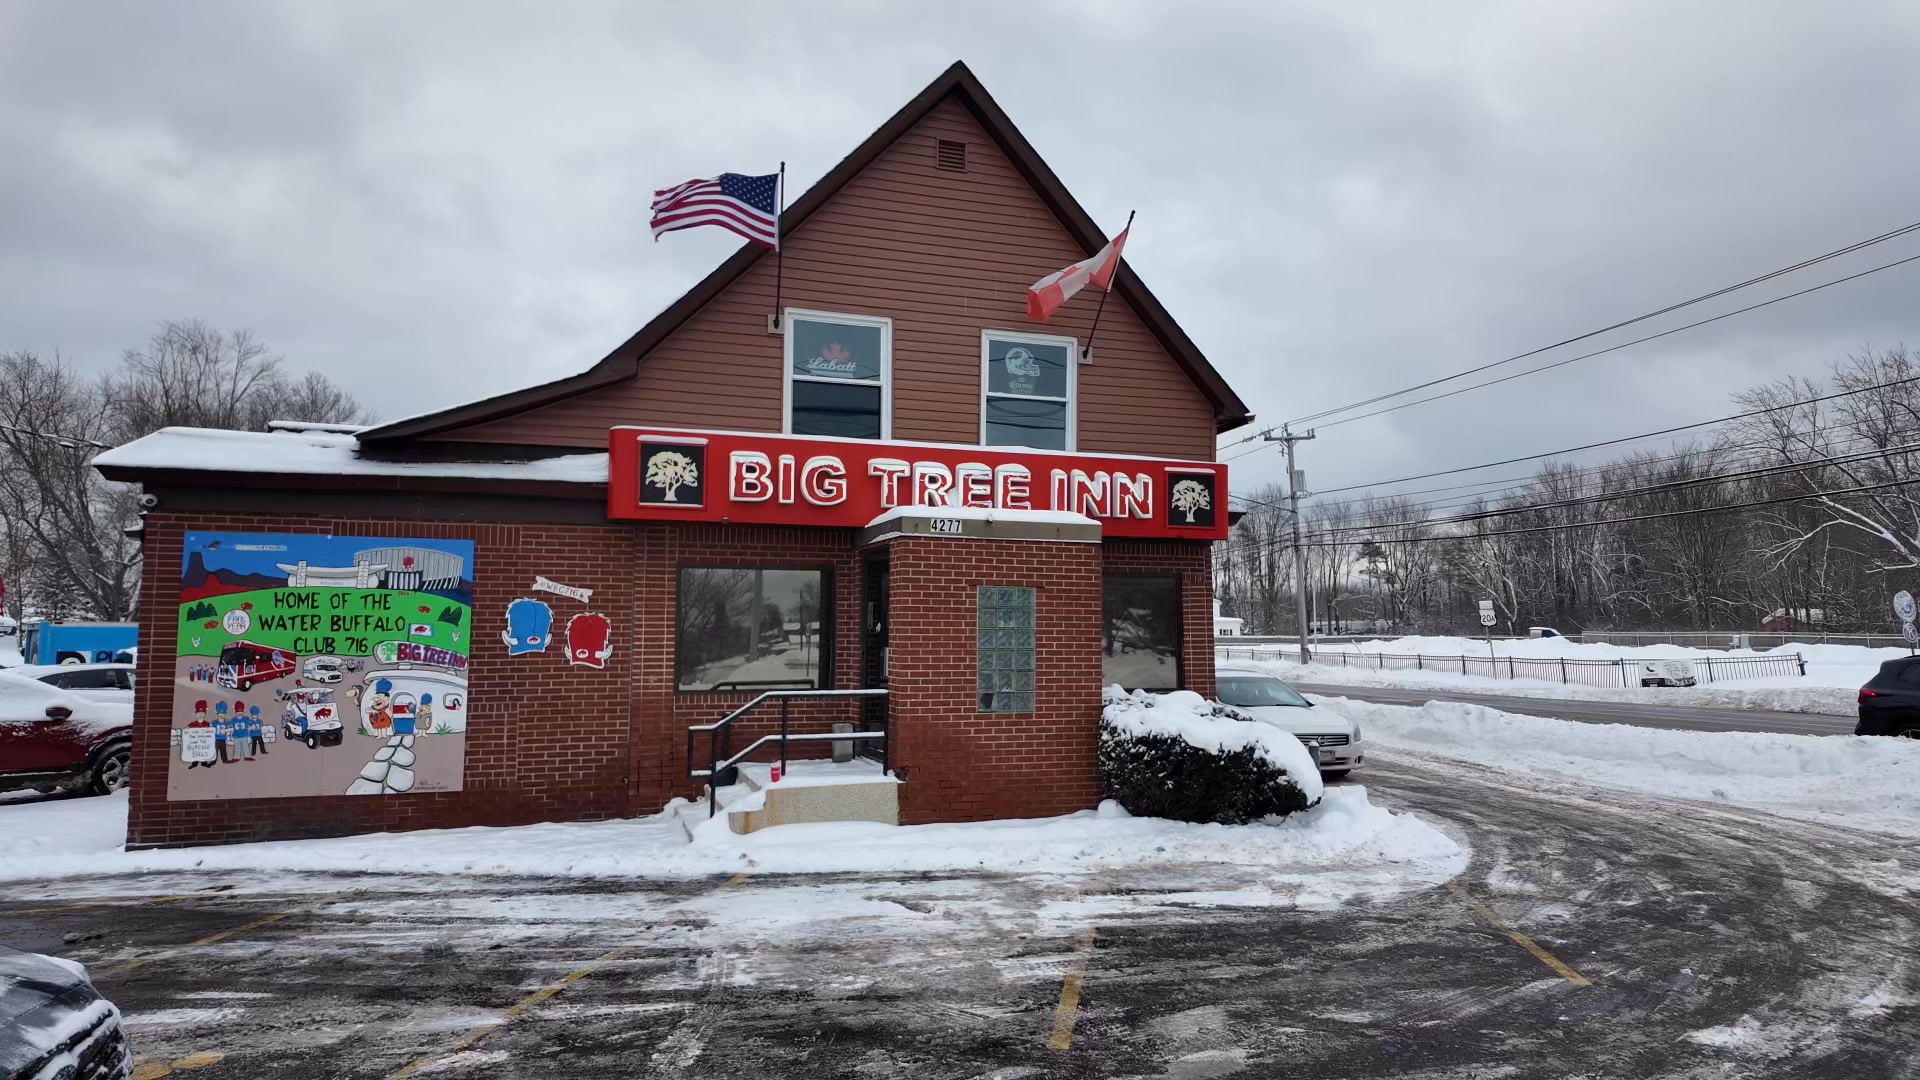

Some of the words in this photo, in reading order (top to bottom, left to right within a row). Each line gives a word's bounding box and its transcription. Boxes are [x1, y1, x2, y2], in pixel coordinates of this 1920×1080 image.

[806, 357, 857, 372] Labatt
[729, 451, 847, 506] BIG
[868, 458, 1032, 509] TREE
[1050, 468, 1153, 519] INN
[931, 519, 961, 532] 4277
[274, 592, 320, 609] HOME
[330, 593, 351, 609] OF
[360, 593, 392, 610] THE
[259, 614, 322, 632] WATER
[330, 615, 405, 632] BUFFALO
[1482, 614, 1496, 622] 20A
[294, 637, 336, 653] CLUB
[345, 637, 368, 653] 716
[397, 642, 421, 661] BIG
[423, 646, 449, 666] TREE
[447, 652, 467, 668] INN
